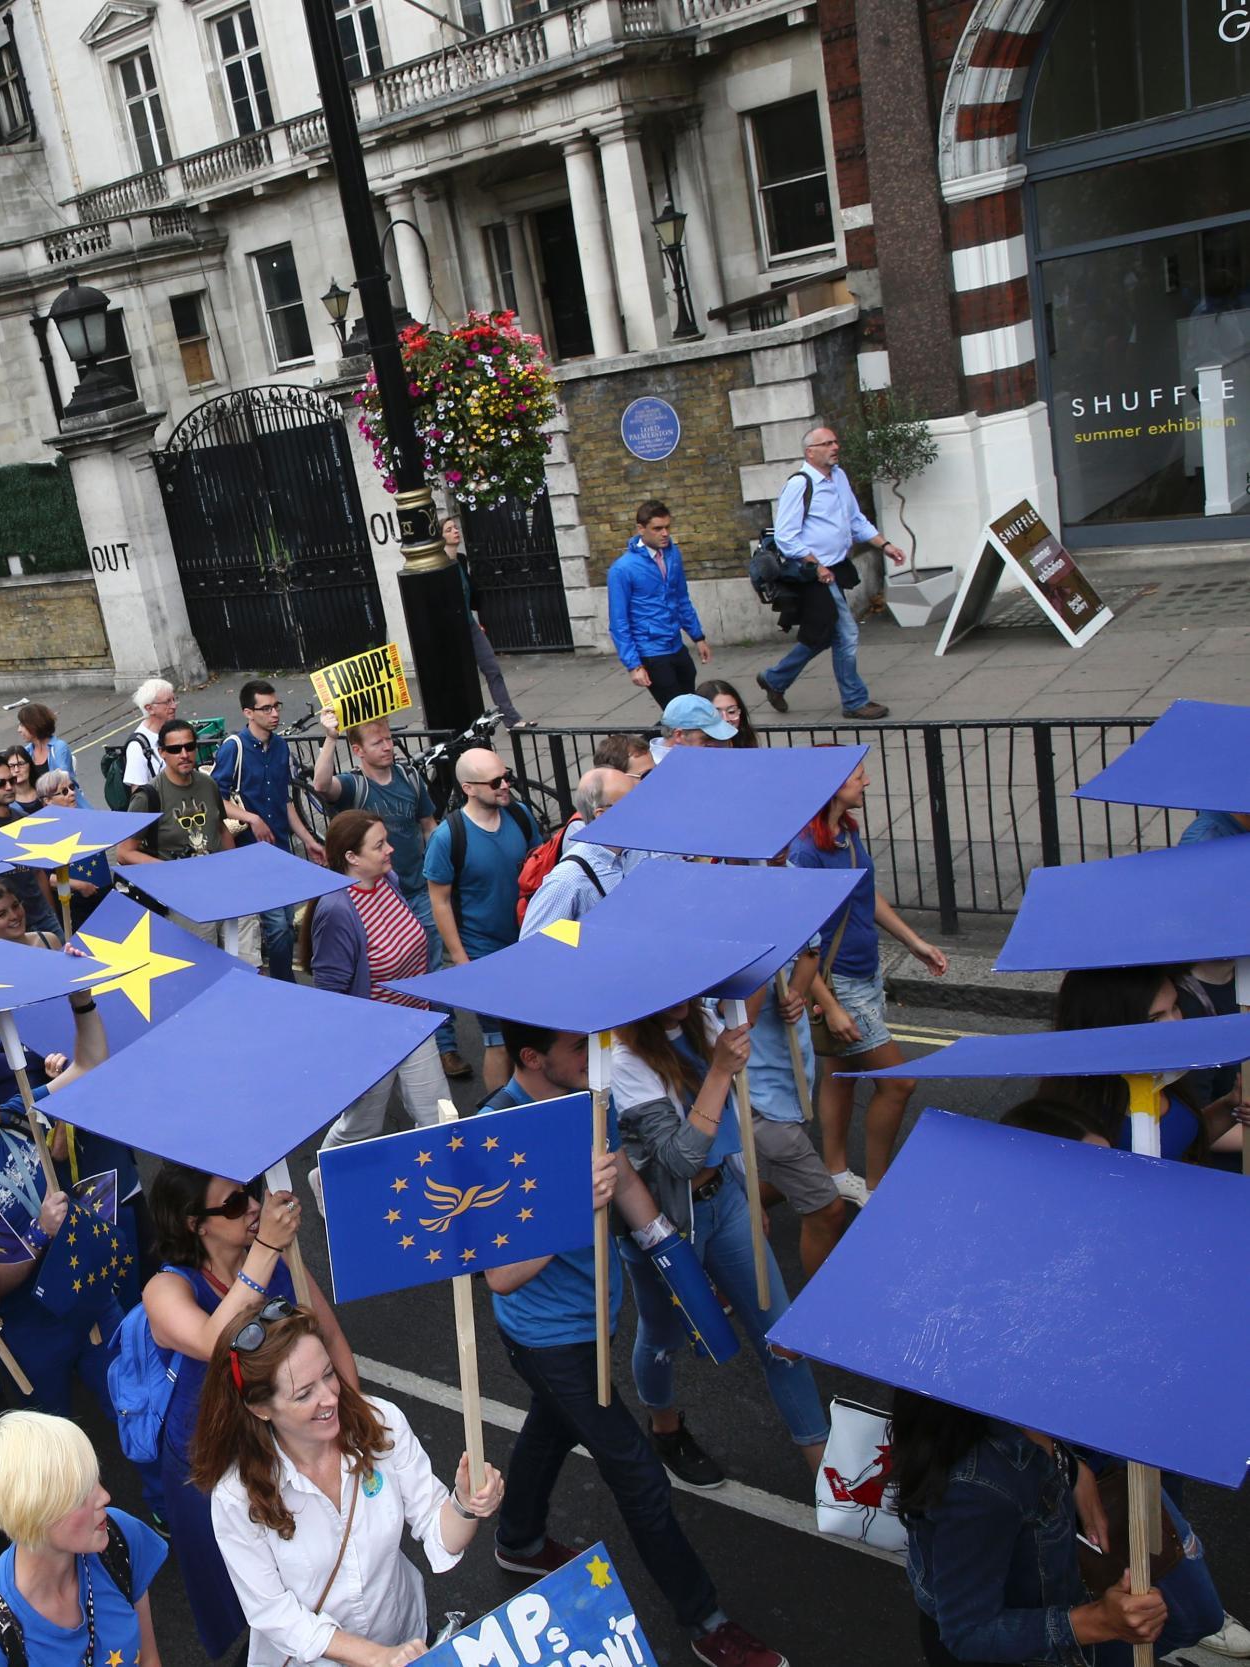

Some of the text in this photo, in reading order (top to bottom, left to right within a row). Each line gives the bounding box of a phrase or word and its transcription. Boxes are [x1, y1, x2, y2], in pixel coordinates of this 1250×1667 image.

[1071, 379, 1235, 417] SHUFFLE
[1074, 416, 1237, 444] summer exhibition
[370, 511, 403, 546] OU
[998, 509, 1040, 544] SHUFFLE
[91, 542, 131, 573] OUT
[322, 647, 395, 699] EUROPE
[340, 681, 395, 727] INNIT!
